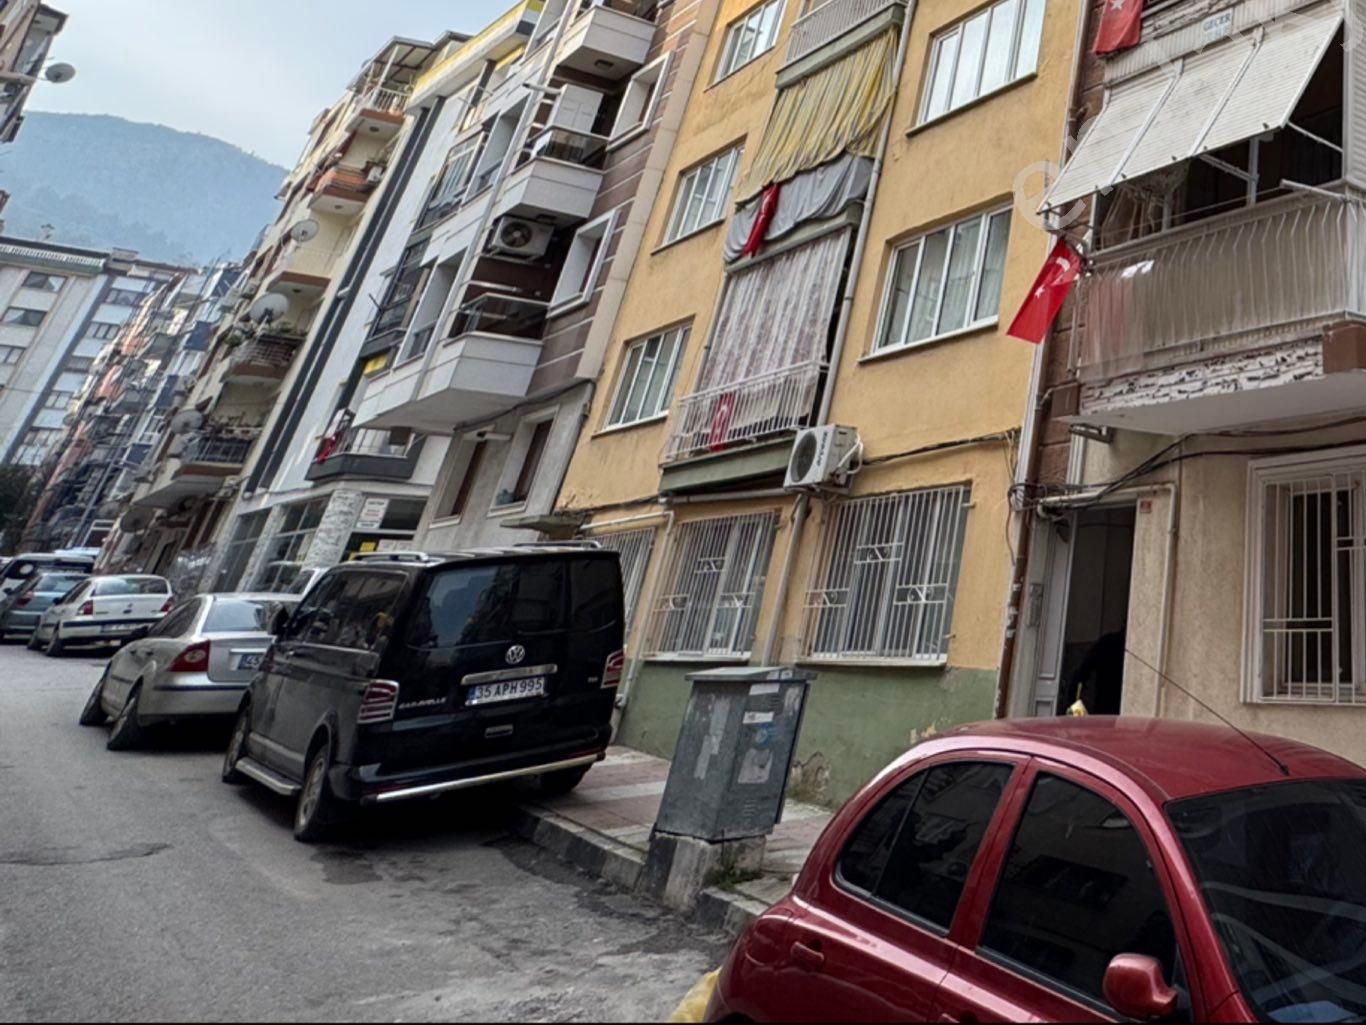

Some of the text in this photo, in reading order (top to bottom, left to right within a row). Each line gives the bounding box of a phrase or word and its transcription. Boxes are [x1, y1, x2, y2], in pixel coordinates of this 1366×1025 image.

[476, 678, 543, 699] 35 APH 995
